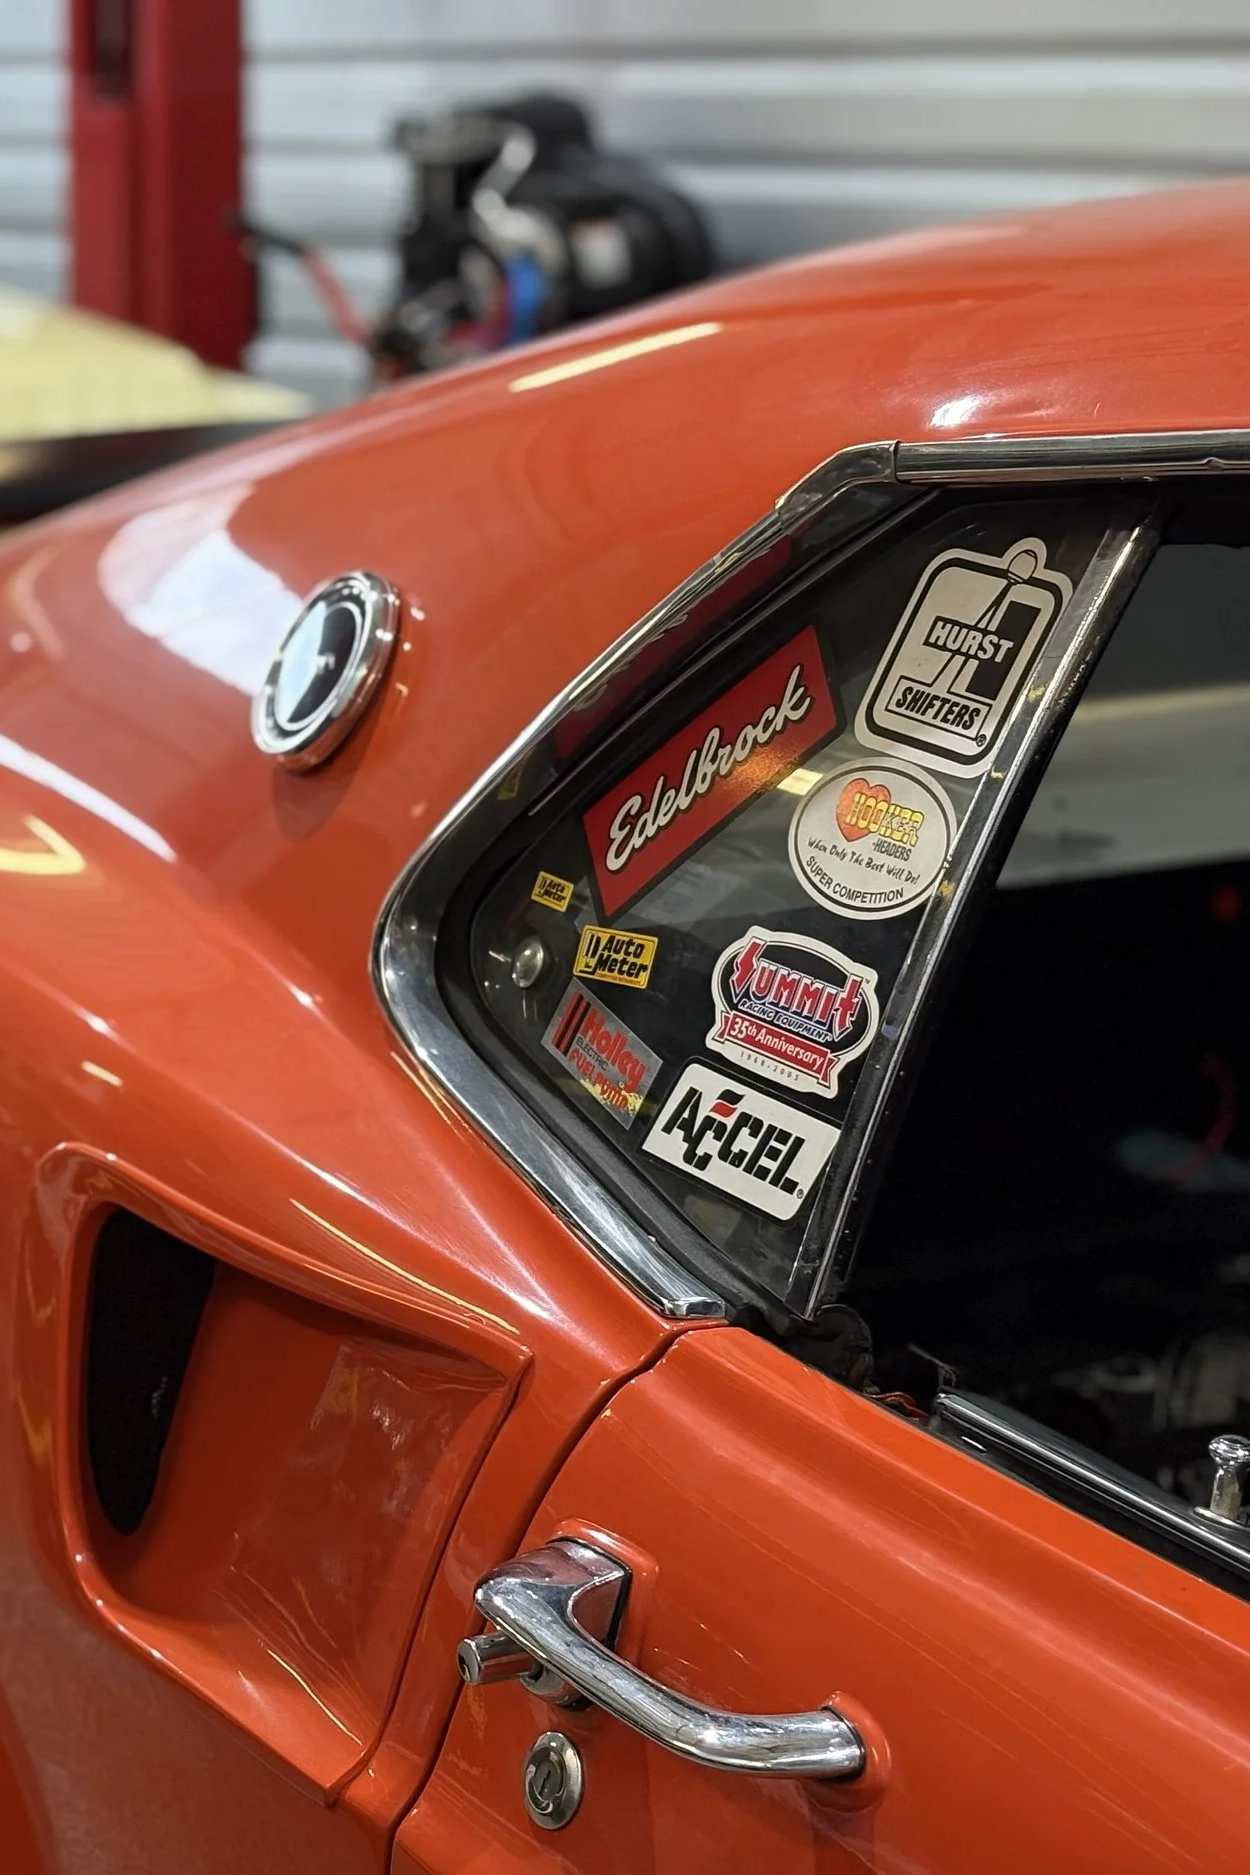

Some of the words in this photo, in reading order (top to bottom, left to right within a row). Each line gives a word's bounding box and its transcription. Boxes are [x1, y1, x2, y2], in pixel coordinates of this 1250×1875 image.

[928, 620, 1014, 663] HURST
[895, 686, 981, 731] SHIFTERS
[605, 664, 812, 872] Edelbrock
[845, 791, 925, 848] HOOKER
[807, 837, 828, 853] When
[829, 844, 848, 861] Only
[848, 851, 865, 866] The
[865, 857, 885, 873] Best
[886, 864, 905, 880] Will
[873, 838, 912, 861] HEADERS
[806, 856, 834, 890] SUPER
[832, 882, 904, 904] COMPETITION
[595, 952, 648, 979] Meter
[601, 935, 646, 959] Auto
[738, 999, 775, 1019] RACING
[774, 1012, 829, 1042] EQUIPMENT
[575, 1036, 610, 1071] ELECTRIC
[578, 1007, 647, 1094] Holley
[730, 1018, 757, 1039] 35th
[755, 1028, 825, 1071] Anniversary
[661, 1086, 806, 1196] ACCEL
